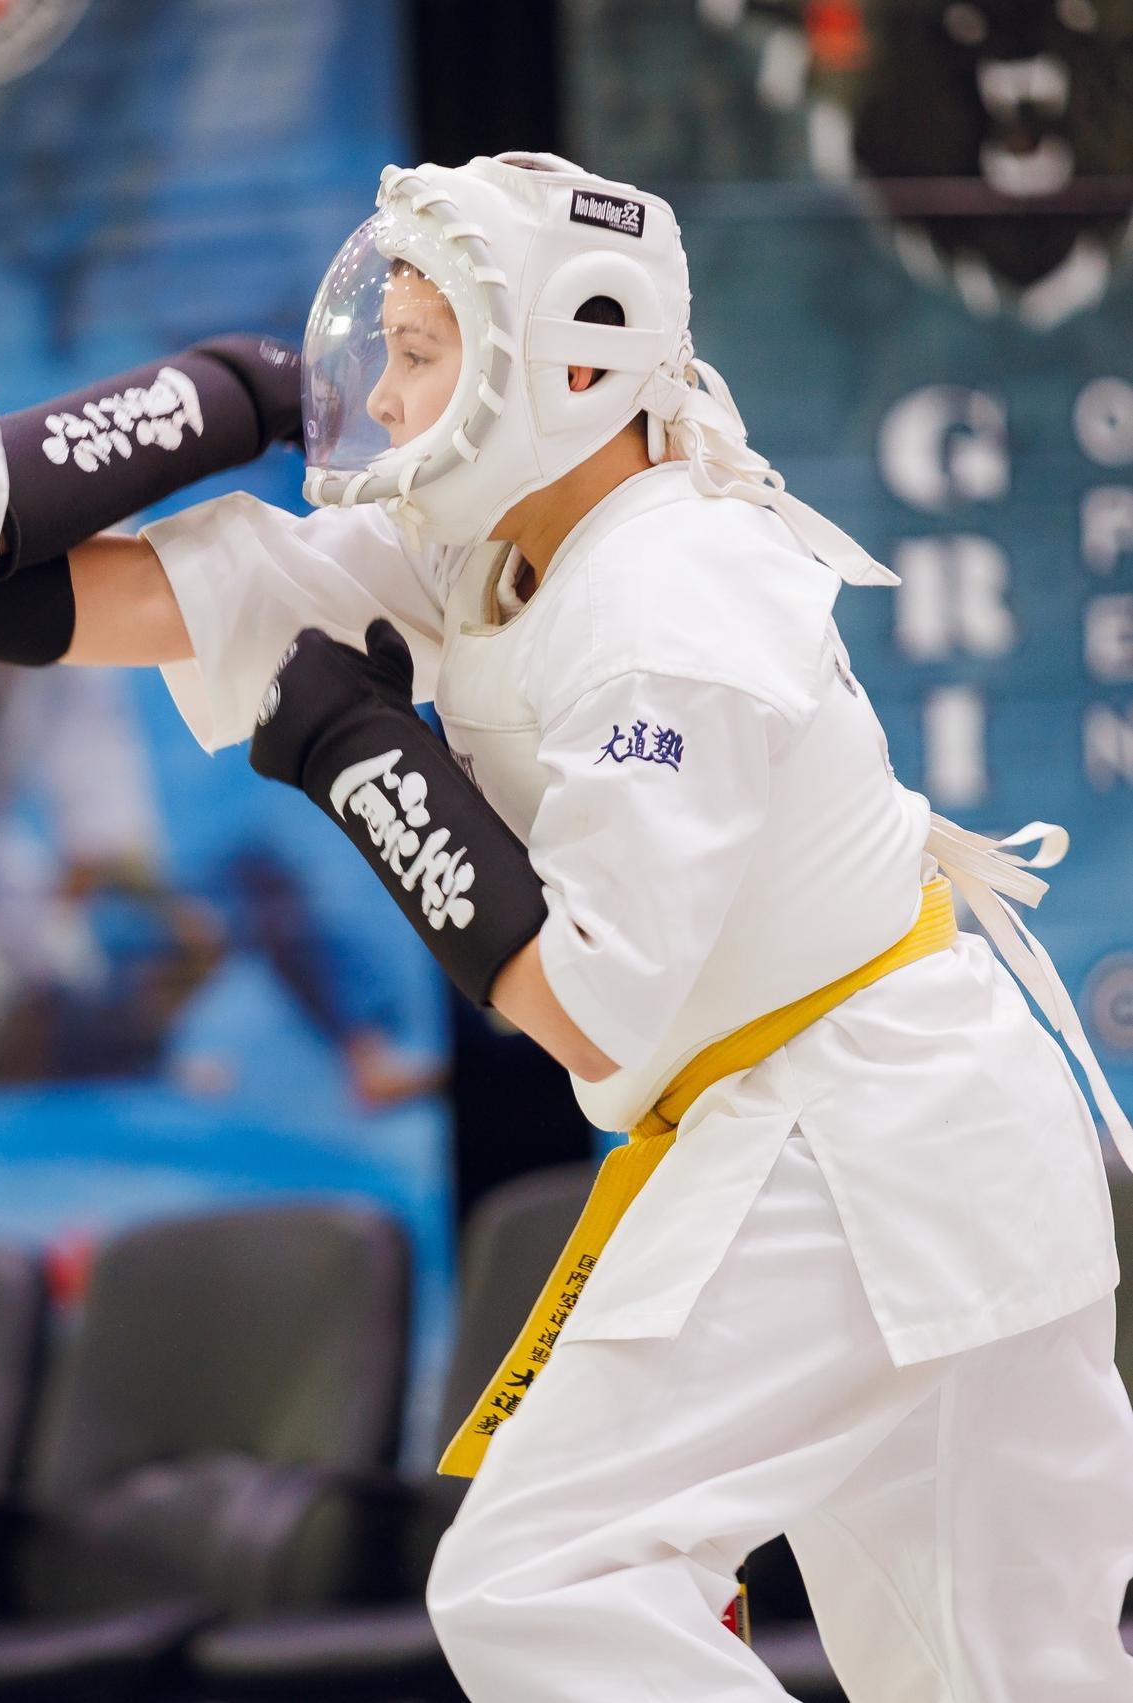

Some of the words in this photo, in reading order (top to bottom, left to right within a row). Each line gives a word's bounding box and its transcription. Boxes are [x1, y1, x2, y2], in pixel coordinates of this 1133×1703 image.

[574, 194, 589, 216] Neo
[588, 197, 607, 220] Head
[606, 201, 623, 223] Gear
[877, 384, 1020, 935] GRI
[593, 719, 684, 772] 大道塾
